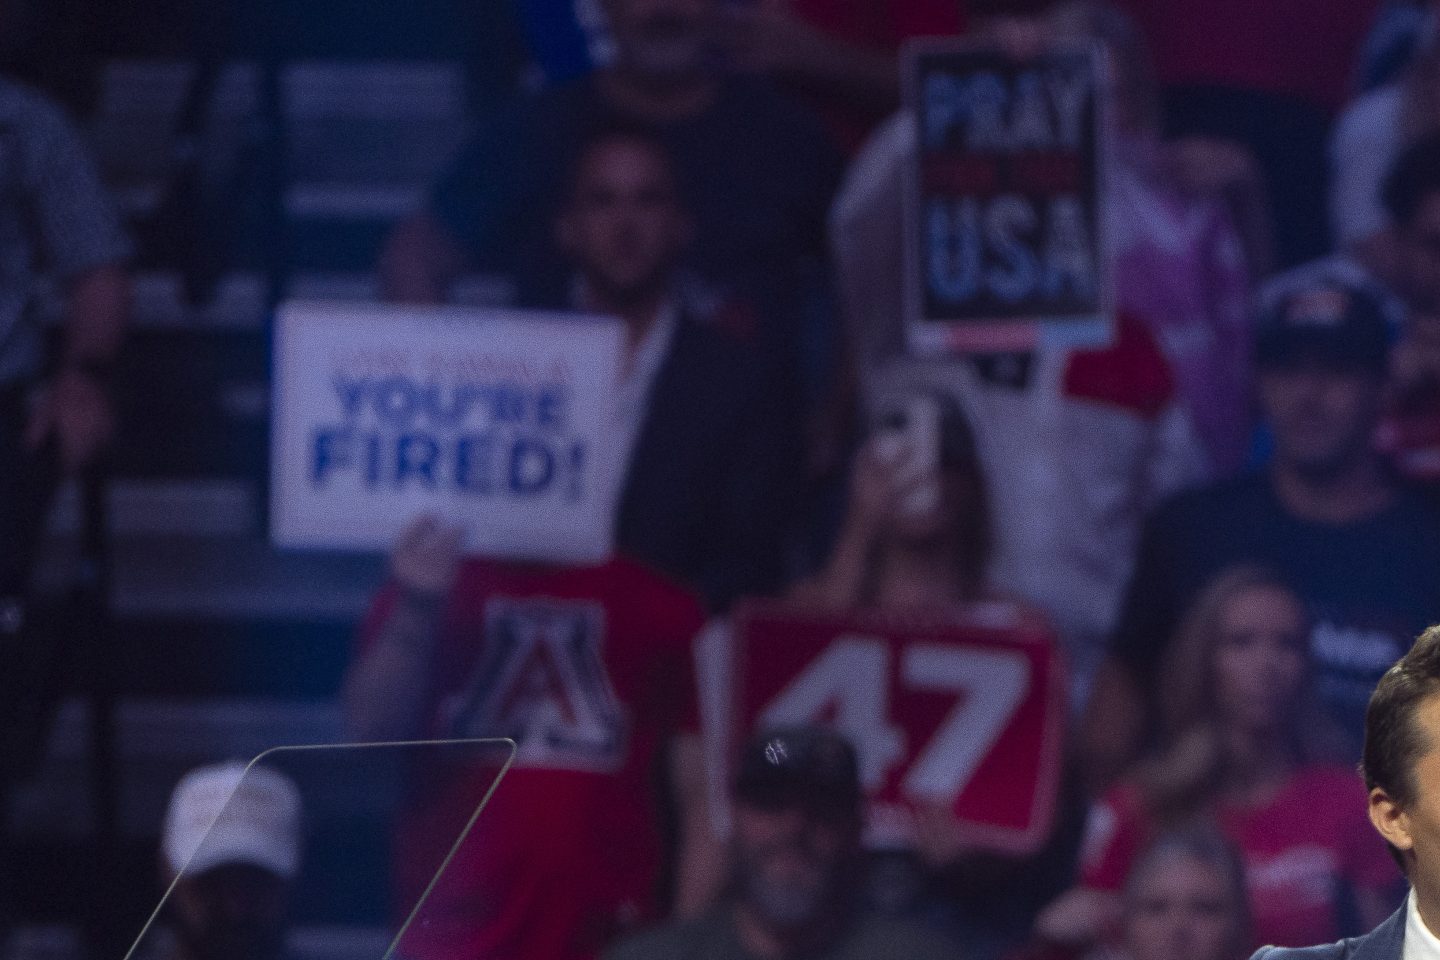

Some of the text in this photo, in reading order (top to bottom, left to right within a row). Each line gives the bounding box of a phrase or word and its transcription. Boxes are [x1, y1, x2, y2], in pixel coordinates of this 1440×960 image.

[925, 70, 1092, 149] PRAY
[927, 197, 1097, 301] USA
[311, 428, 584, 504] FIRED!
[755, 634, 1034, 801] 47
